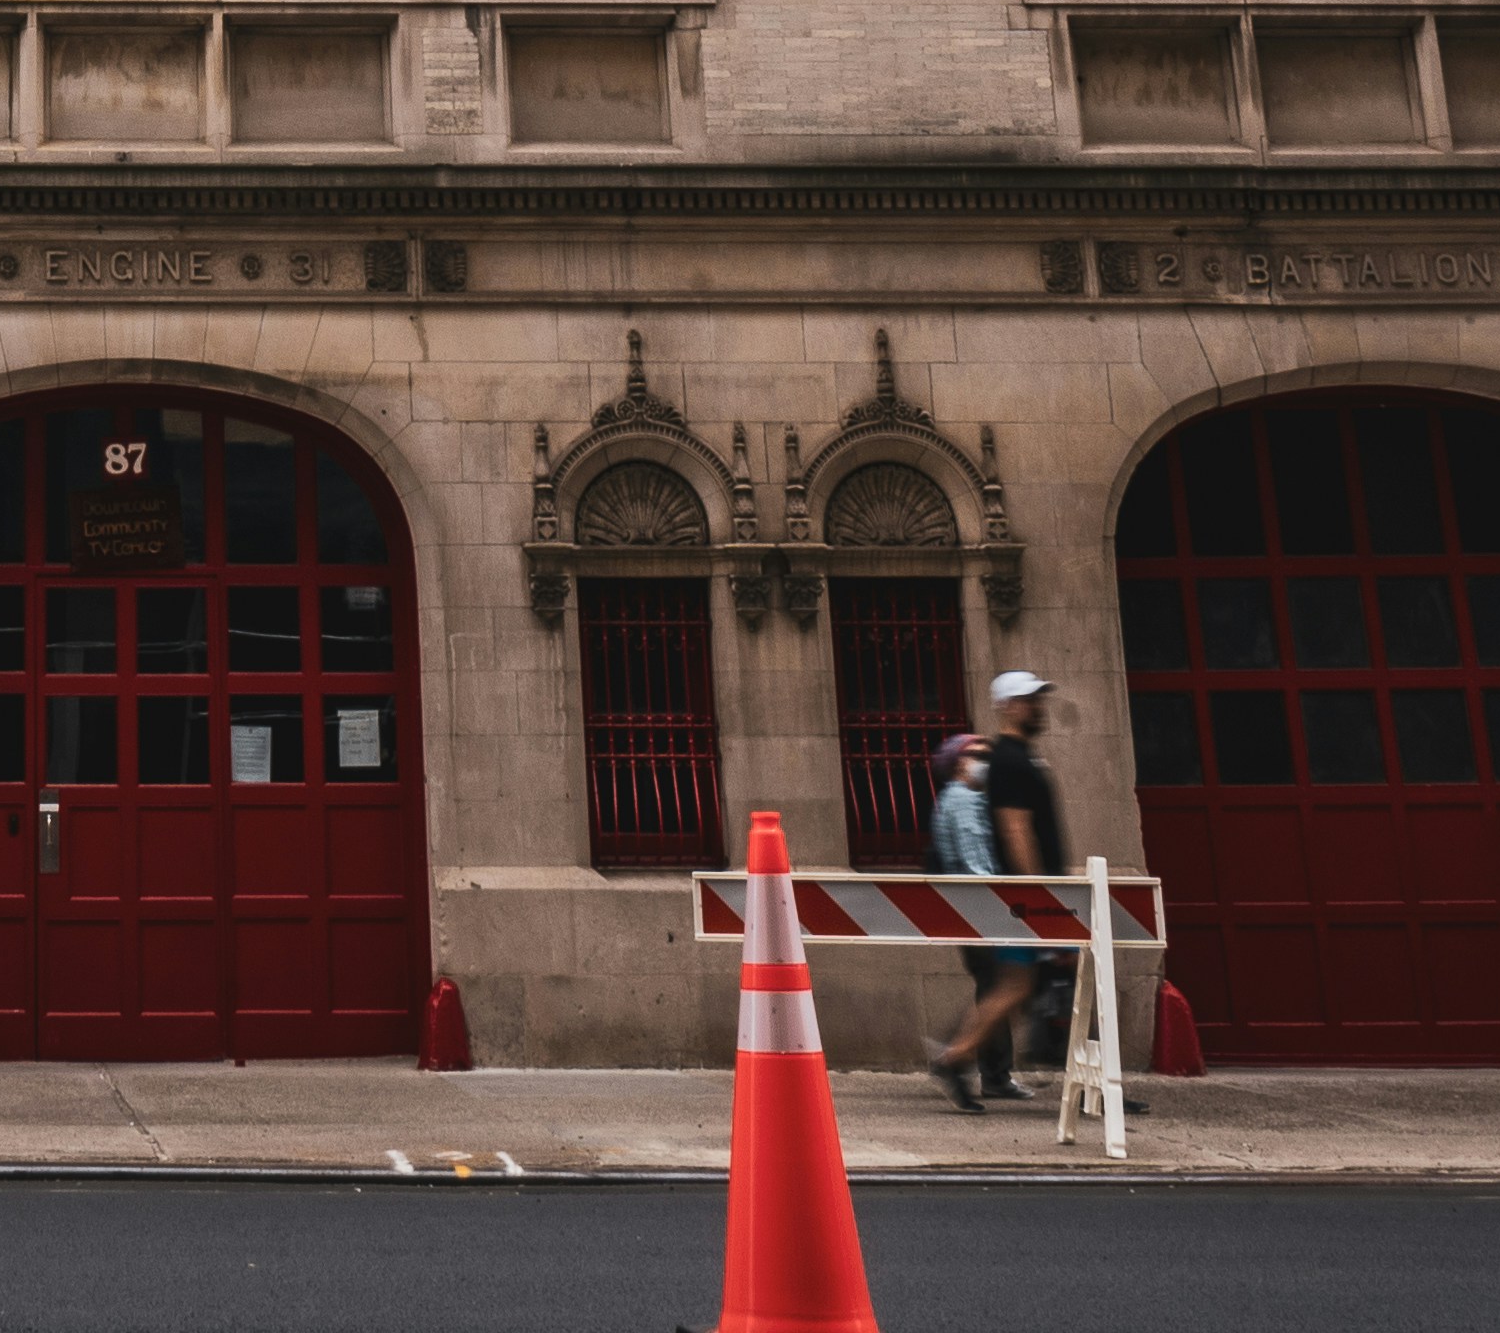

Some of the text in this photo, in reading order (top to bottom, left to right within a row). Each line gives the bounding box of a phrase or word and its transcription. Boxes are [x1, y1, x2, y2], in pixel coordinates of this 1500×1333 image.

[44, 248, 214, 285] ENGINE
[288, 249, 332, 284] 31
[1154, 251, 1181, 285] 2
[1245, 250, 1494, 288] BATTALION
[104, 442, 148, 475] 87
